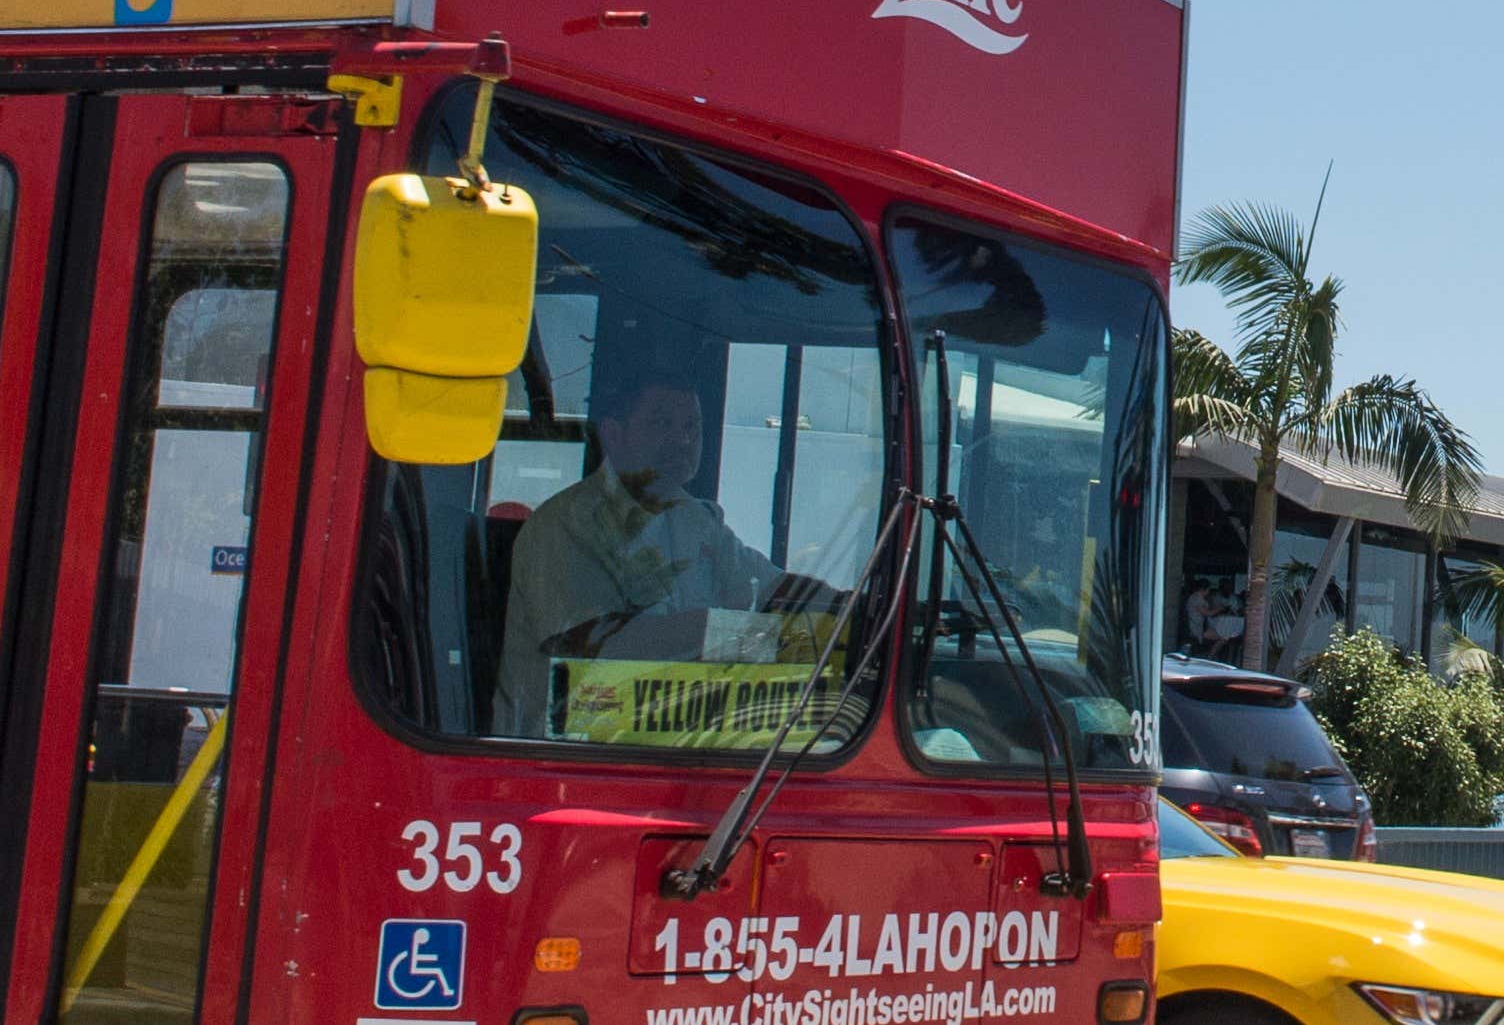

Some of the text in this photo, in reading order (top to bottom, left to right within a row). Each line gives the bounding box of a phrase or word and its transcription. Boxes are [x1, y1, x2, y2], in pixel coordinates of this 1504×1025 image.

[215, 549, 246, 567] Oce
[633, 679, 732, 733] YELLOW
[1129, 708, 1161, 767] 35
[396, 819, 523, 894] 353
[653, 910, 1060, 986] 1-855-4LAHOPON
